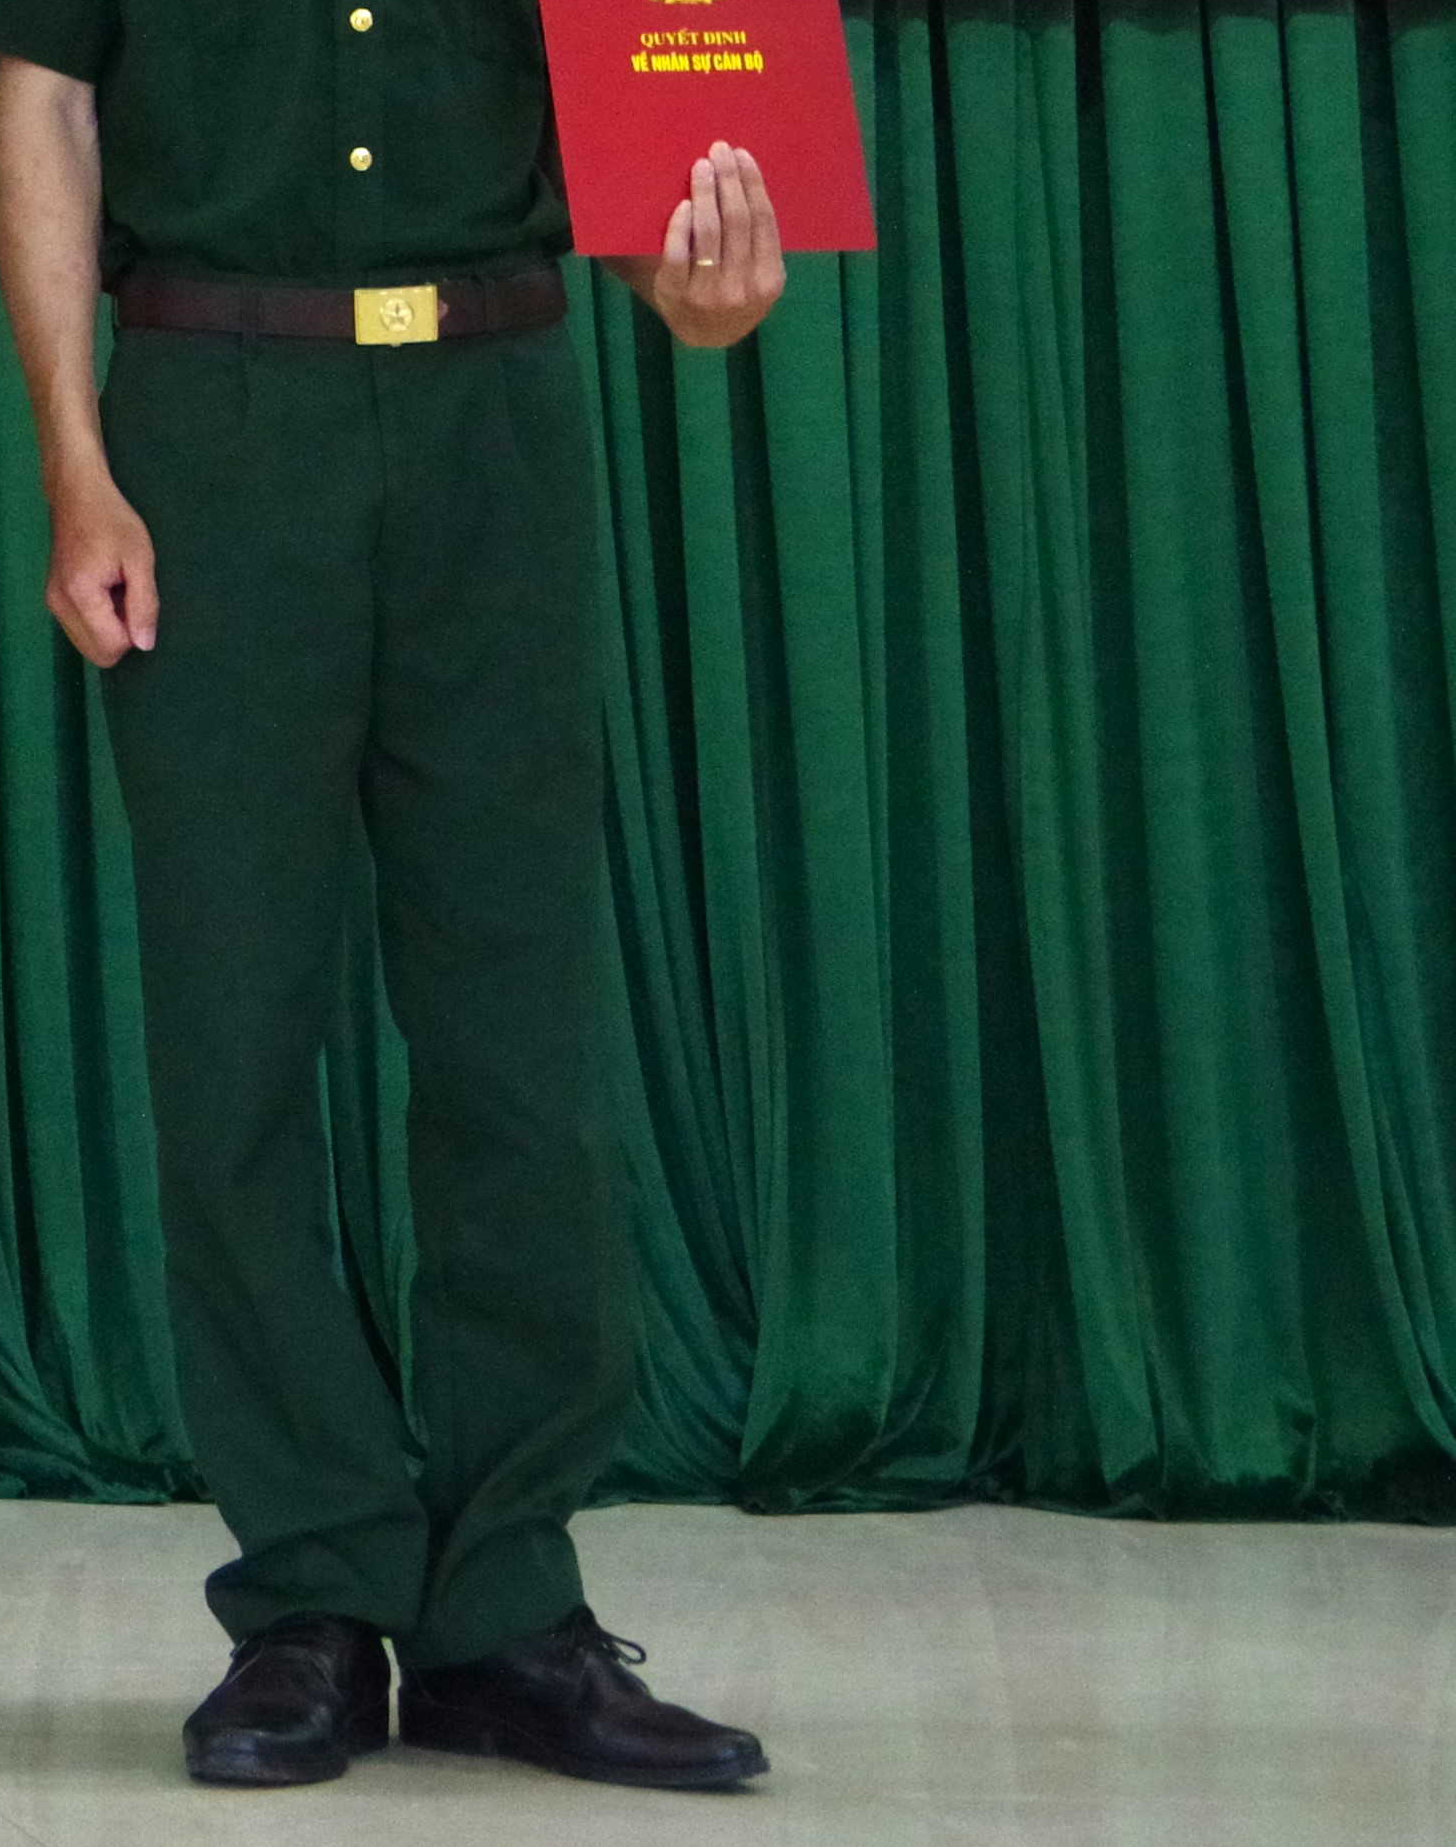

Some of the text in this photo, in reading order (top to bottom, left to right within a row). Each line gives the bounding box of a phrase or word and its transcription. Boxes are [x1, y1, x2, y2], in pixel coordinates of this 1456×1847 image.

[640, 27, 747, 48] QUYẾT ĐỊNH
[651, 52, 690, 72] NHÂN
[713, 51, 742, 71] CÁN
[743, 49, 764, 74] BỘ
